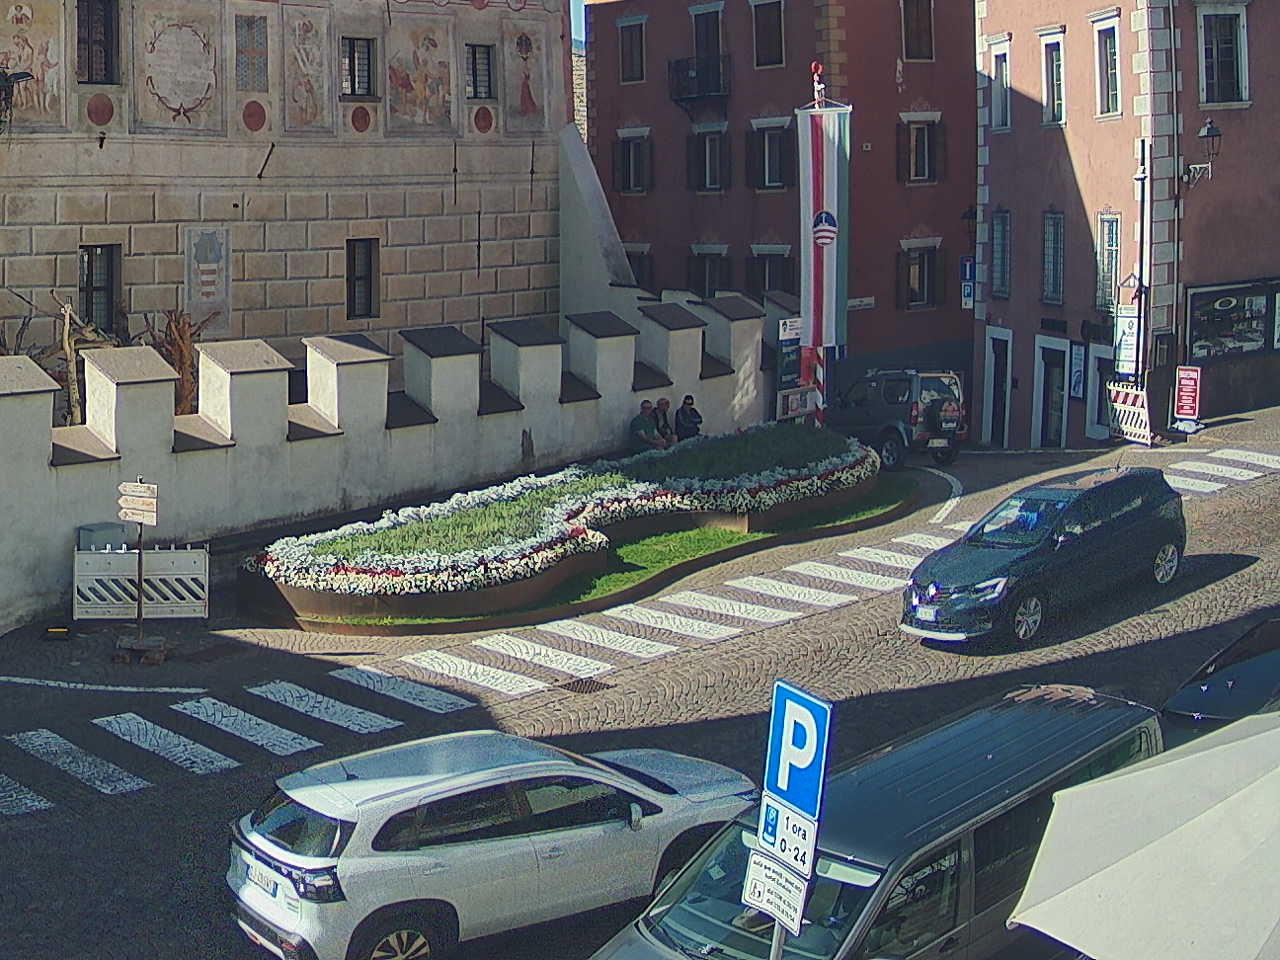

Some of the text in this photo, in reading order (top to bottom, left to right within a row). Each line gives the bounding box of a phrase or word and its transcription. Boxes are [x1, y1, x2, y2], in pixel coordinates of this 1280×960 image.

[776, 698, 818, 792] P
[785, 815, 807, 841] 1 ora
